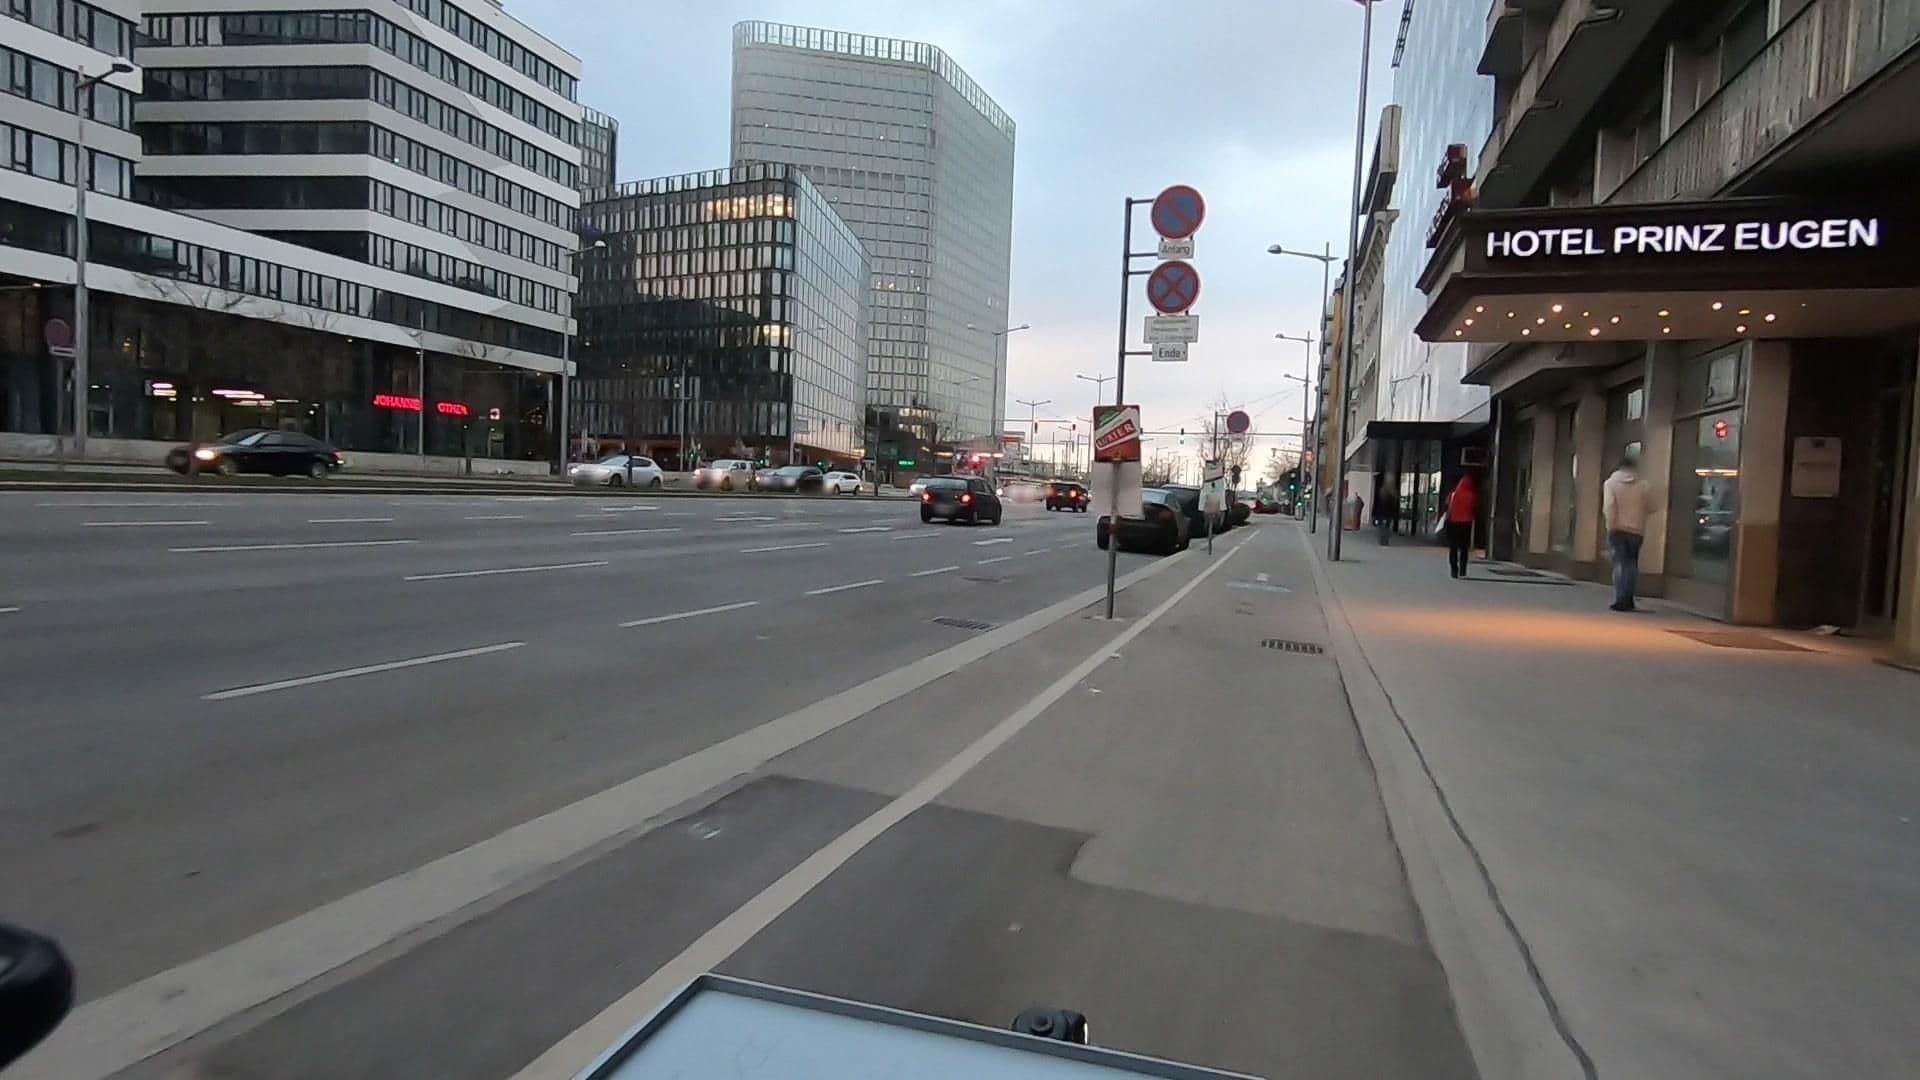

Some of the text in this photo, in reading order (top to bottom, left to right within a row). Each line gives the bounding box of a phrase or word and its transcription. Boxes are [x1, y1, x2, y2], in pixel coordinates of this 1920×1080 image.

[1486, 218, 1879, 257] HOTEL PRINZ EUGEN
[1161, 244, 1190, 255] Anfang
[1158, 347, 1181, 358] Ende
